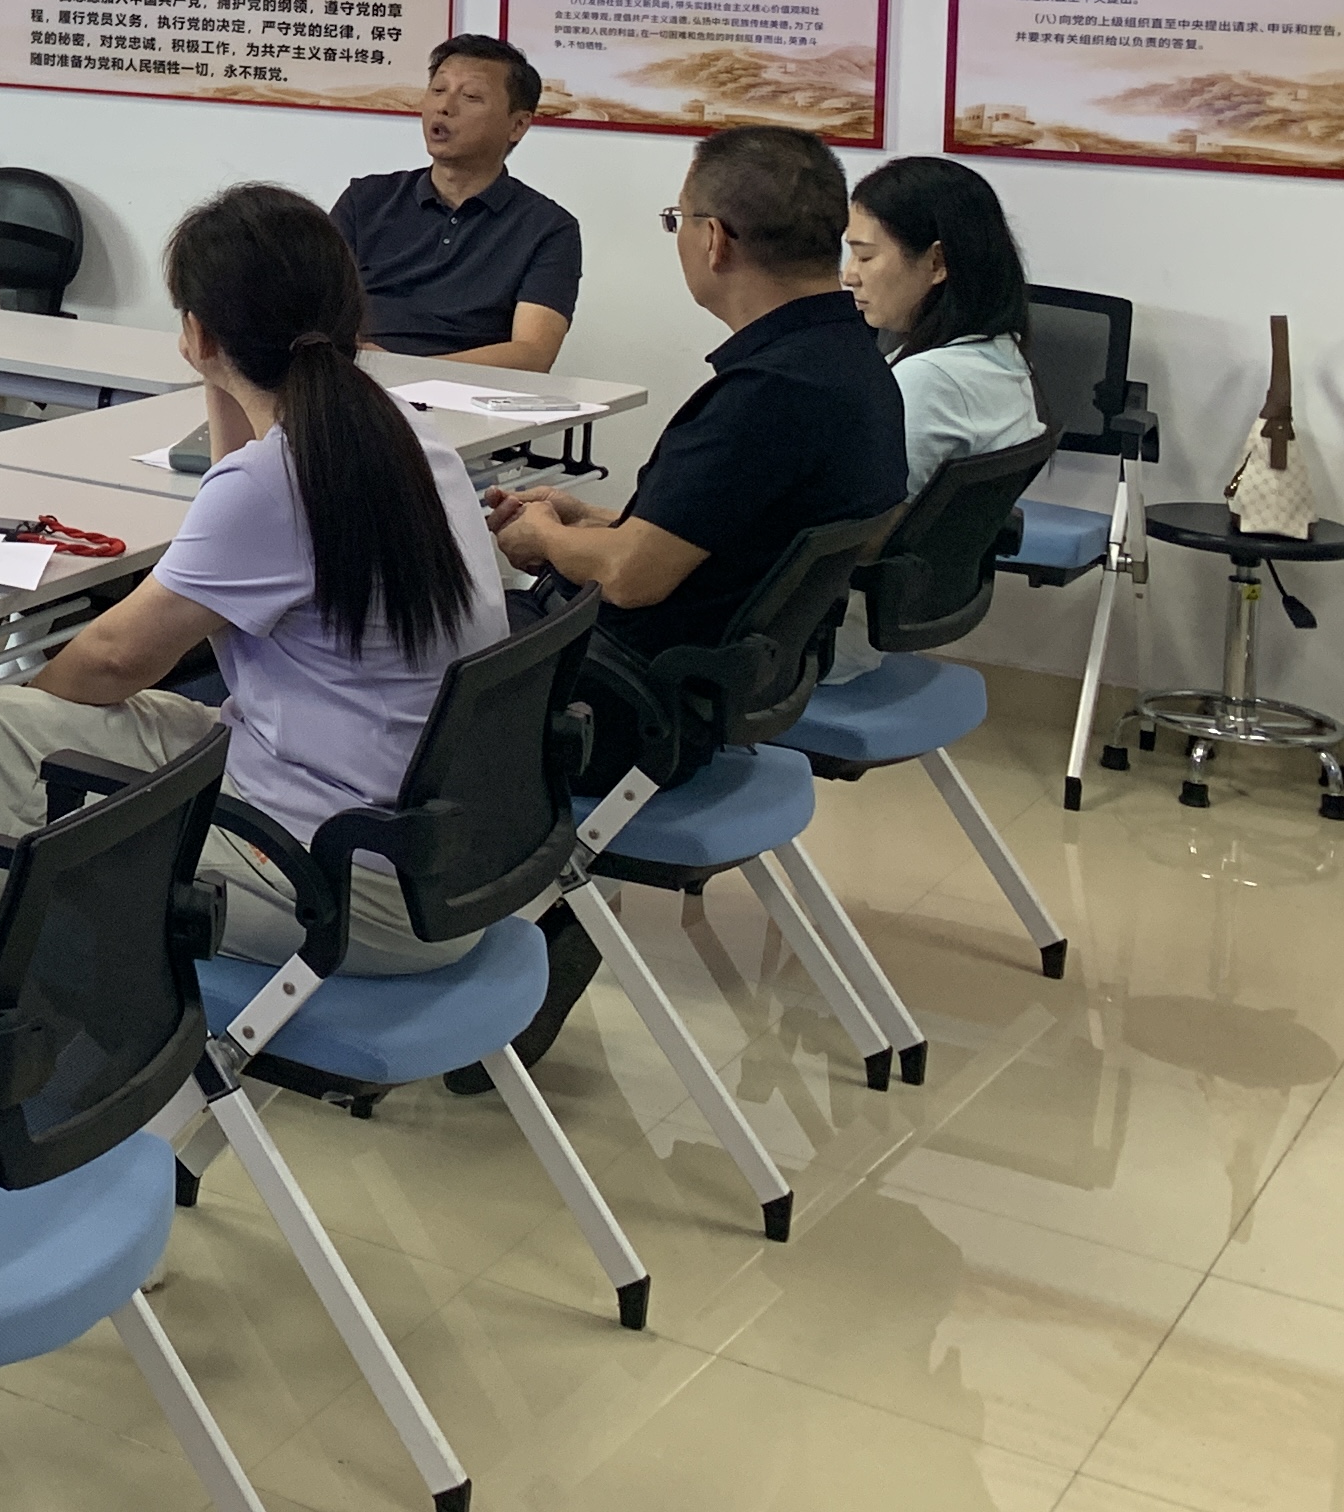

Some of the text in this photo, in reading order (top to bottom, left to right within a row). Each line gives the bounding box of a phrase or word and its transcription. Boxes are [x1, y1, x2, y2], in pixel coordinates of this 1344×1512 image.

[31, 9, 401, 42] 程，履行党员义务，执行党的决定，严守党的纪律，保守
[31, 31, 391, 65] 党的秘密，对党忠诚，积极工作，为共产主义奋斗终身，
[31, 52, 287, 82] 随时准备为党和人民牺牲一切，永不叛党。
